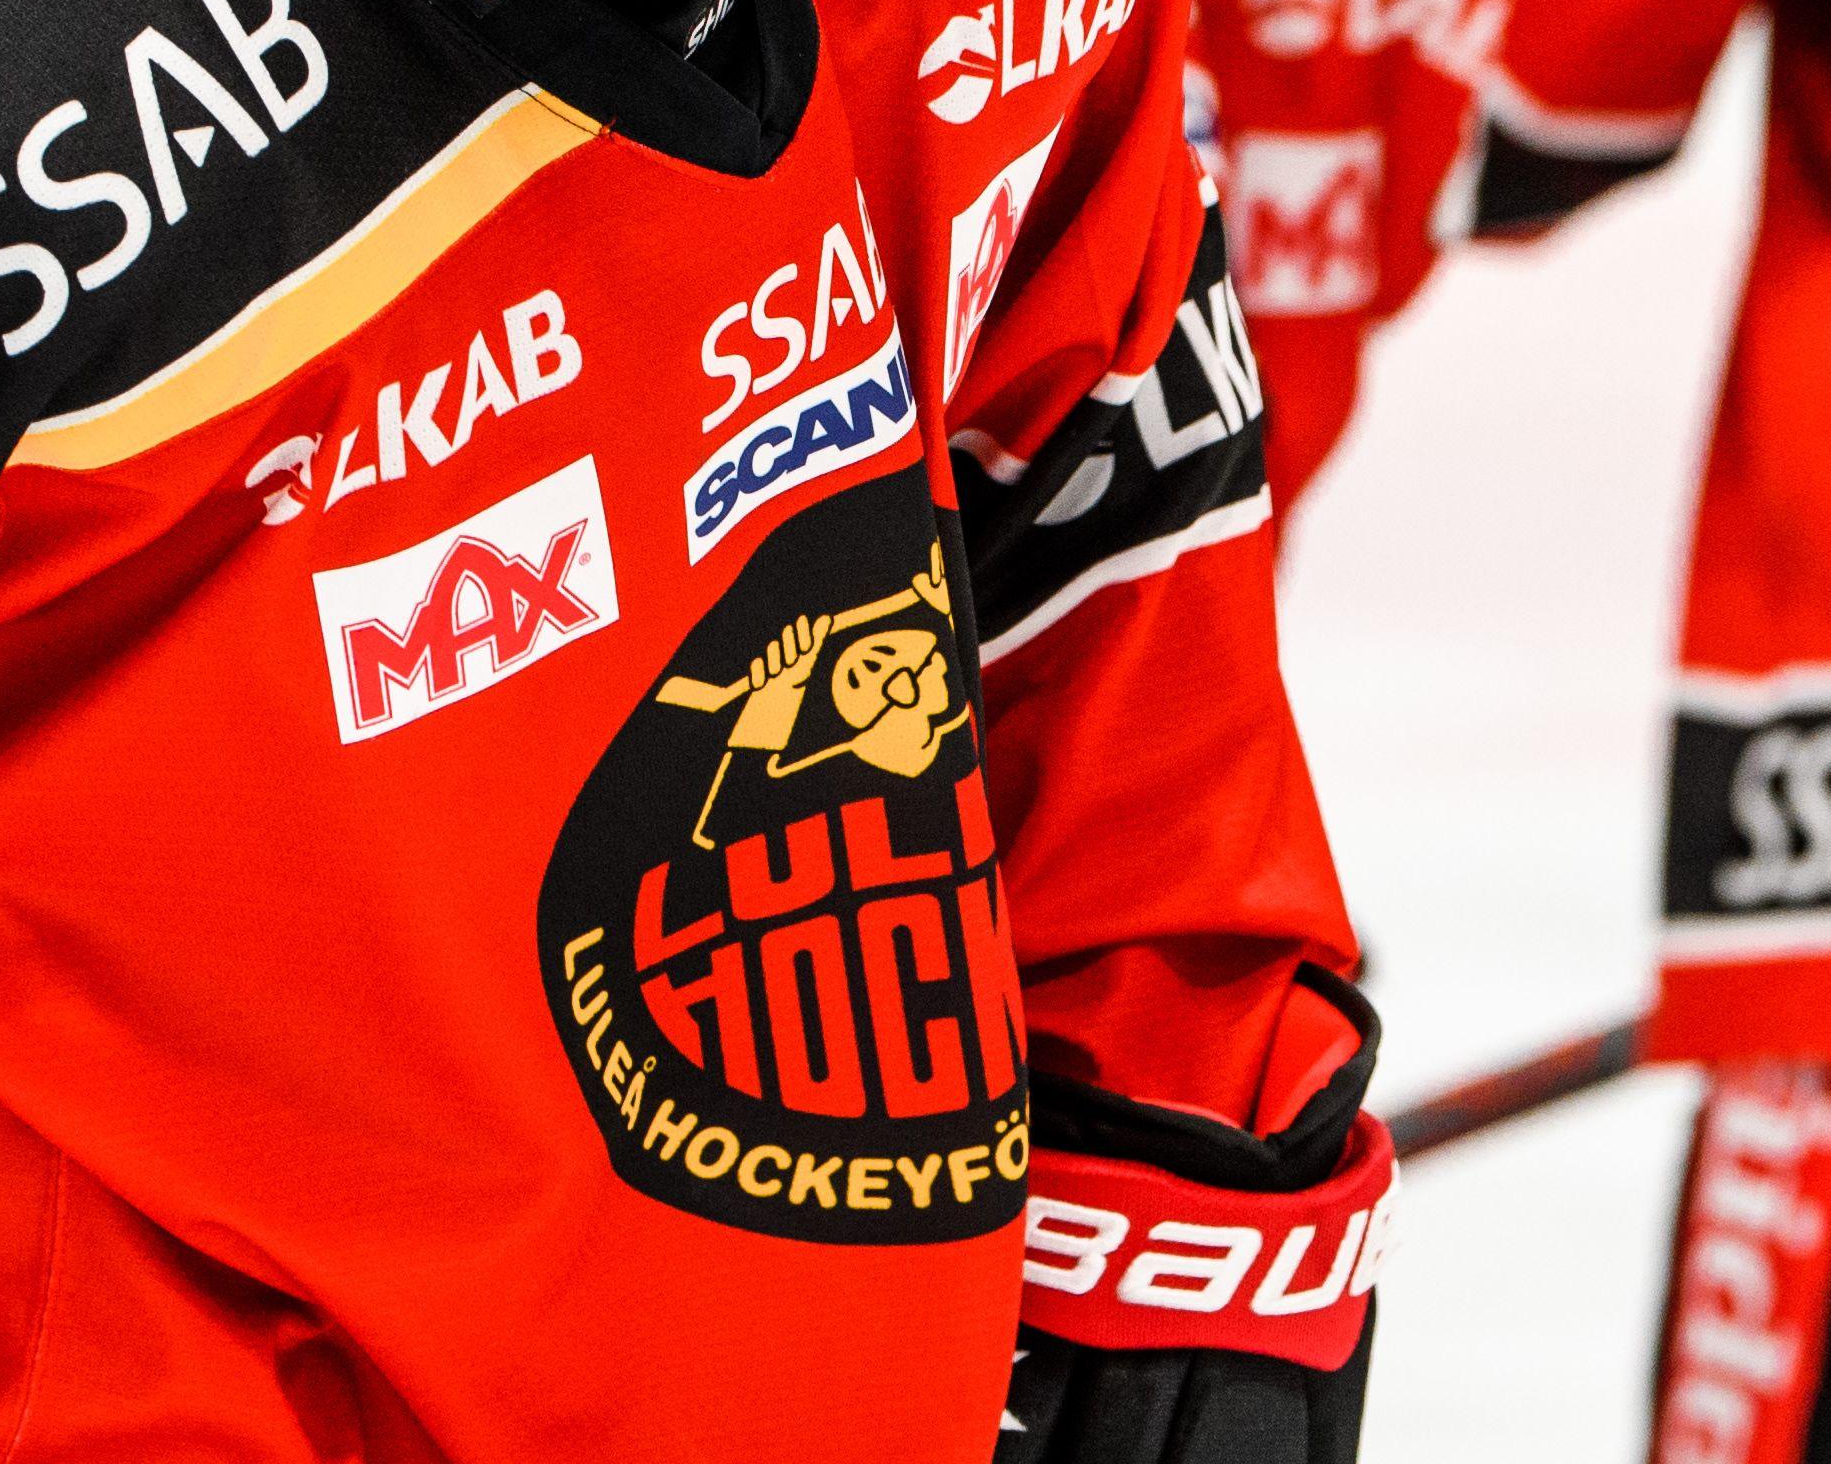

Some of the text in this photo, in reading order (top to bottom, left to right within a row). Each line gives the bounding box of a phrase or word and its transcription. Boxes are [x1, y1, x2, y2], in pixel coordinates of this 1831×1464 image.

[324, 288, 583, 511] LKAB
[694, 344, 914, 538] SCAN
[341, 514, 600, 731] MAX
[563, 926, 1030, 1210] LULEÅ HOCKEYFÖ
